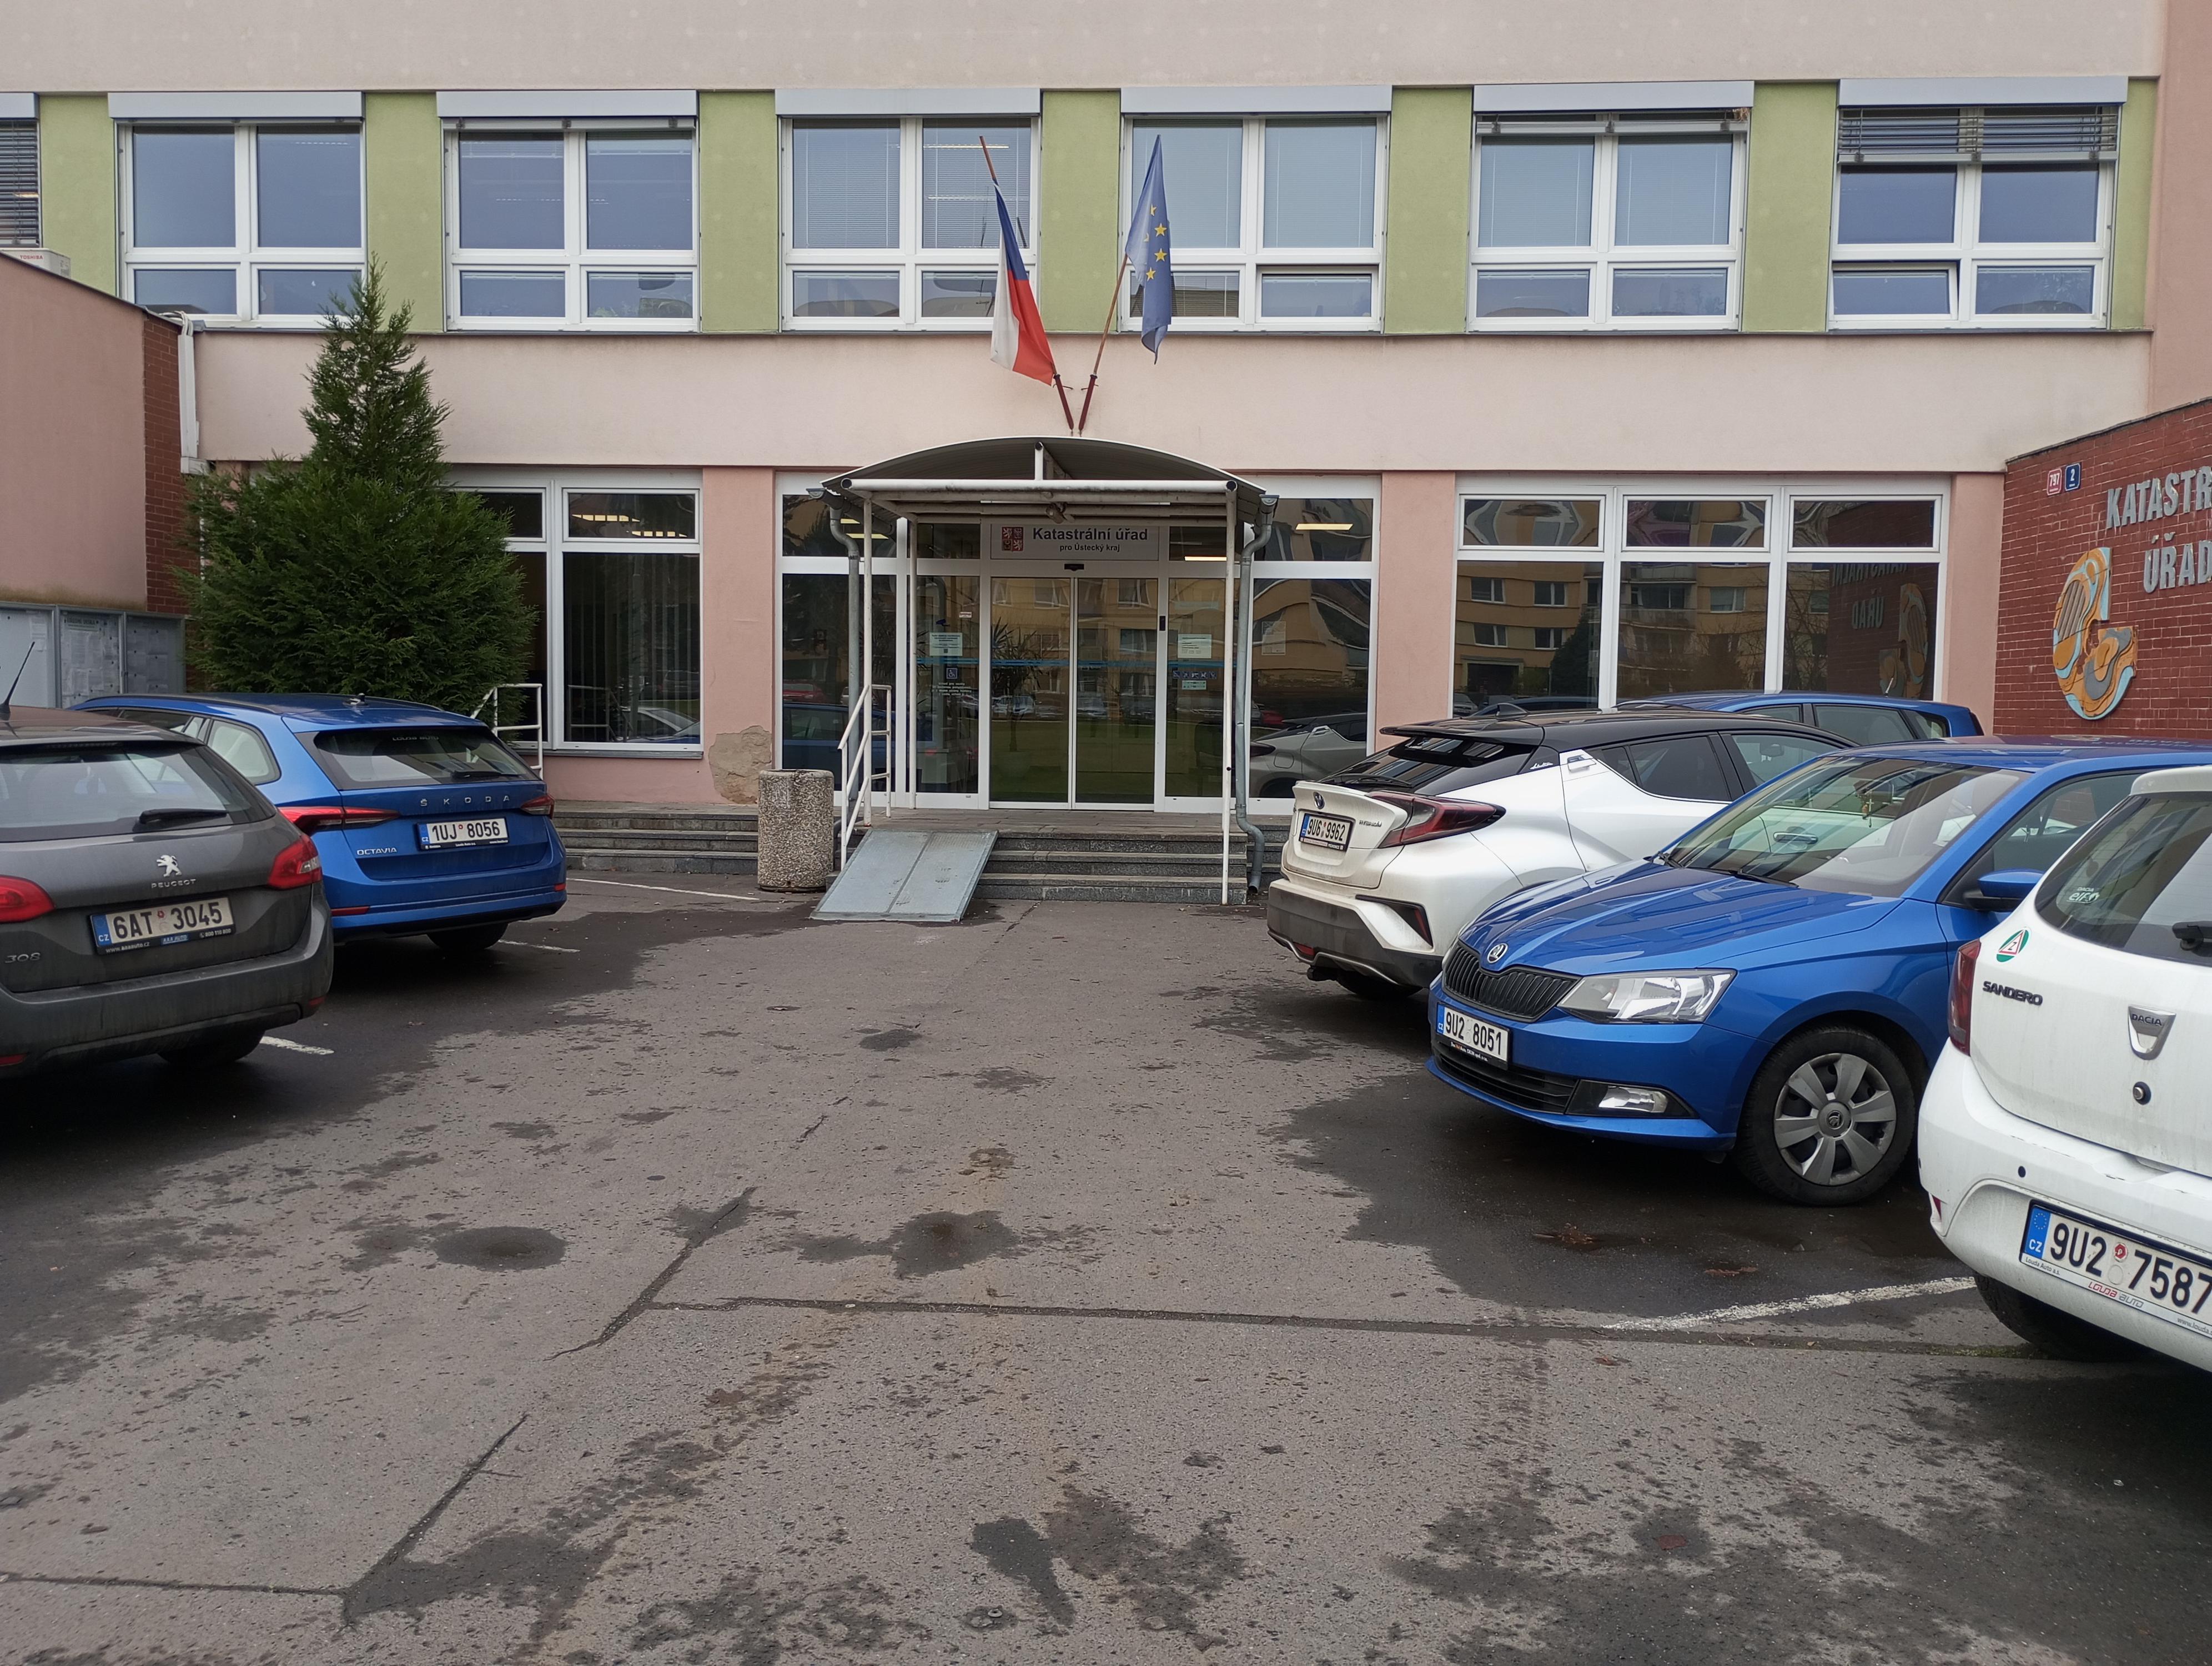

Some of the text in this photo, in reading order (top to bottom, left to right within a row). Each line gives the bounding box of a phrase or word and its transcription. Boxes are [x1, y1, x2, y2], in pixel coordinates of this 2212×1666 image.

[2049, 473, 2060, 487] 797
[2070, 469, 2075, 481] 2
[2106, 466, 2212, 530] KATASTR
[1033, 528, 1148, 540] Katastrální úřad
[1075, 542, 1104, 552] Ústecký
[2144, 532, 2212, 593] ÚŘAD
[420, 795, 510, 806] ŠKODA
[432, 821, 500, 841] 1UJ 8056
[1307, 819, 1346, 841] 9U6 9962
[151, 879, 196, 889] PEUGEOT
[113, 901, 222, 939] 6AT 3045
[4, 952, 41, 963] 308
[1983, 981, 2043, 1006] SANDERO
[2131, 1013, 2162, 1027] DACIA
[1446, 1012, 1465, 1040] 9U2
[1473, 1023, 1501, 1056] 8051
[2029, 1239, 2042, 1253] CZ
[2026, 1257, 2040, 1267] Louda
[2040, 1263, 2052, 1272] Auto
[2050, 1223, 2212, 1314] 9U2 7587
